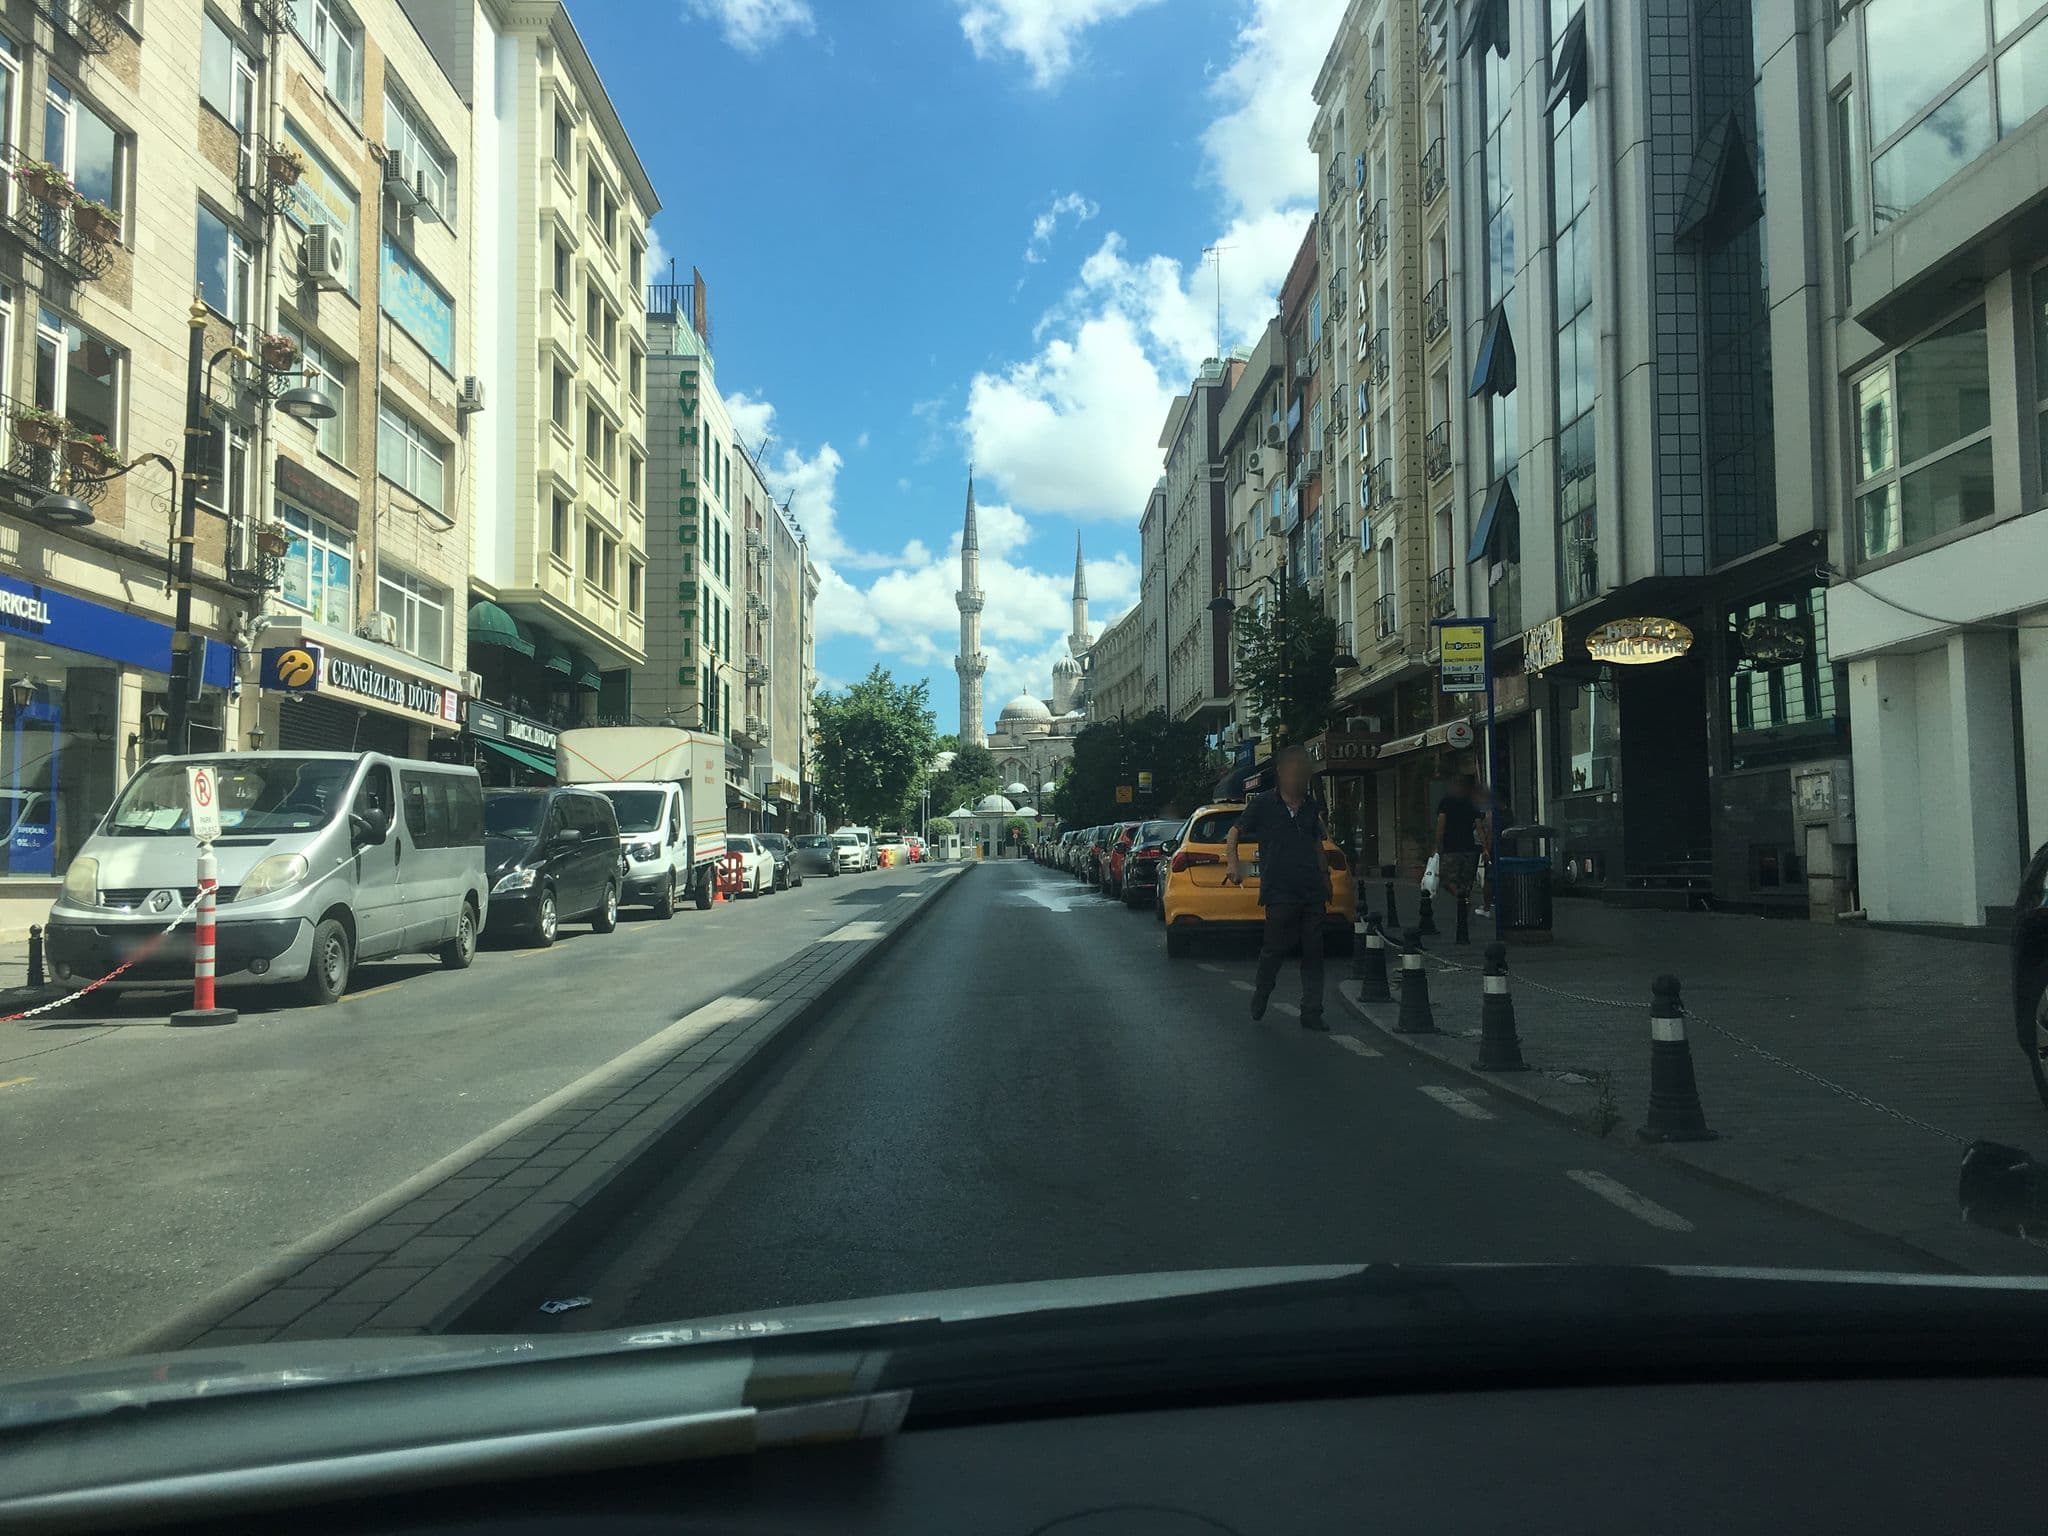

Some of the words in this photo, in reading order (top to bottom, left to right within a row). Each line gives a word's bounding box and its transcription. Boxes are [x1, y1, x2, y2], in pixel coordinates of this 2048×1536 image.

[678, 371, 698, 446] CVH
[678, 468, 698, 686] LOGISTIC
[332, 658, 405, 705] CENGİZLER
[408, 681, 441, 715] DÖVİZ
